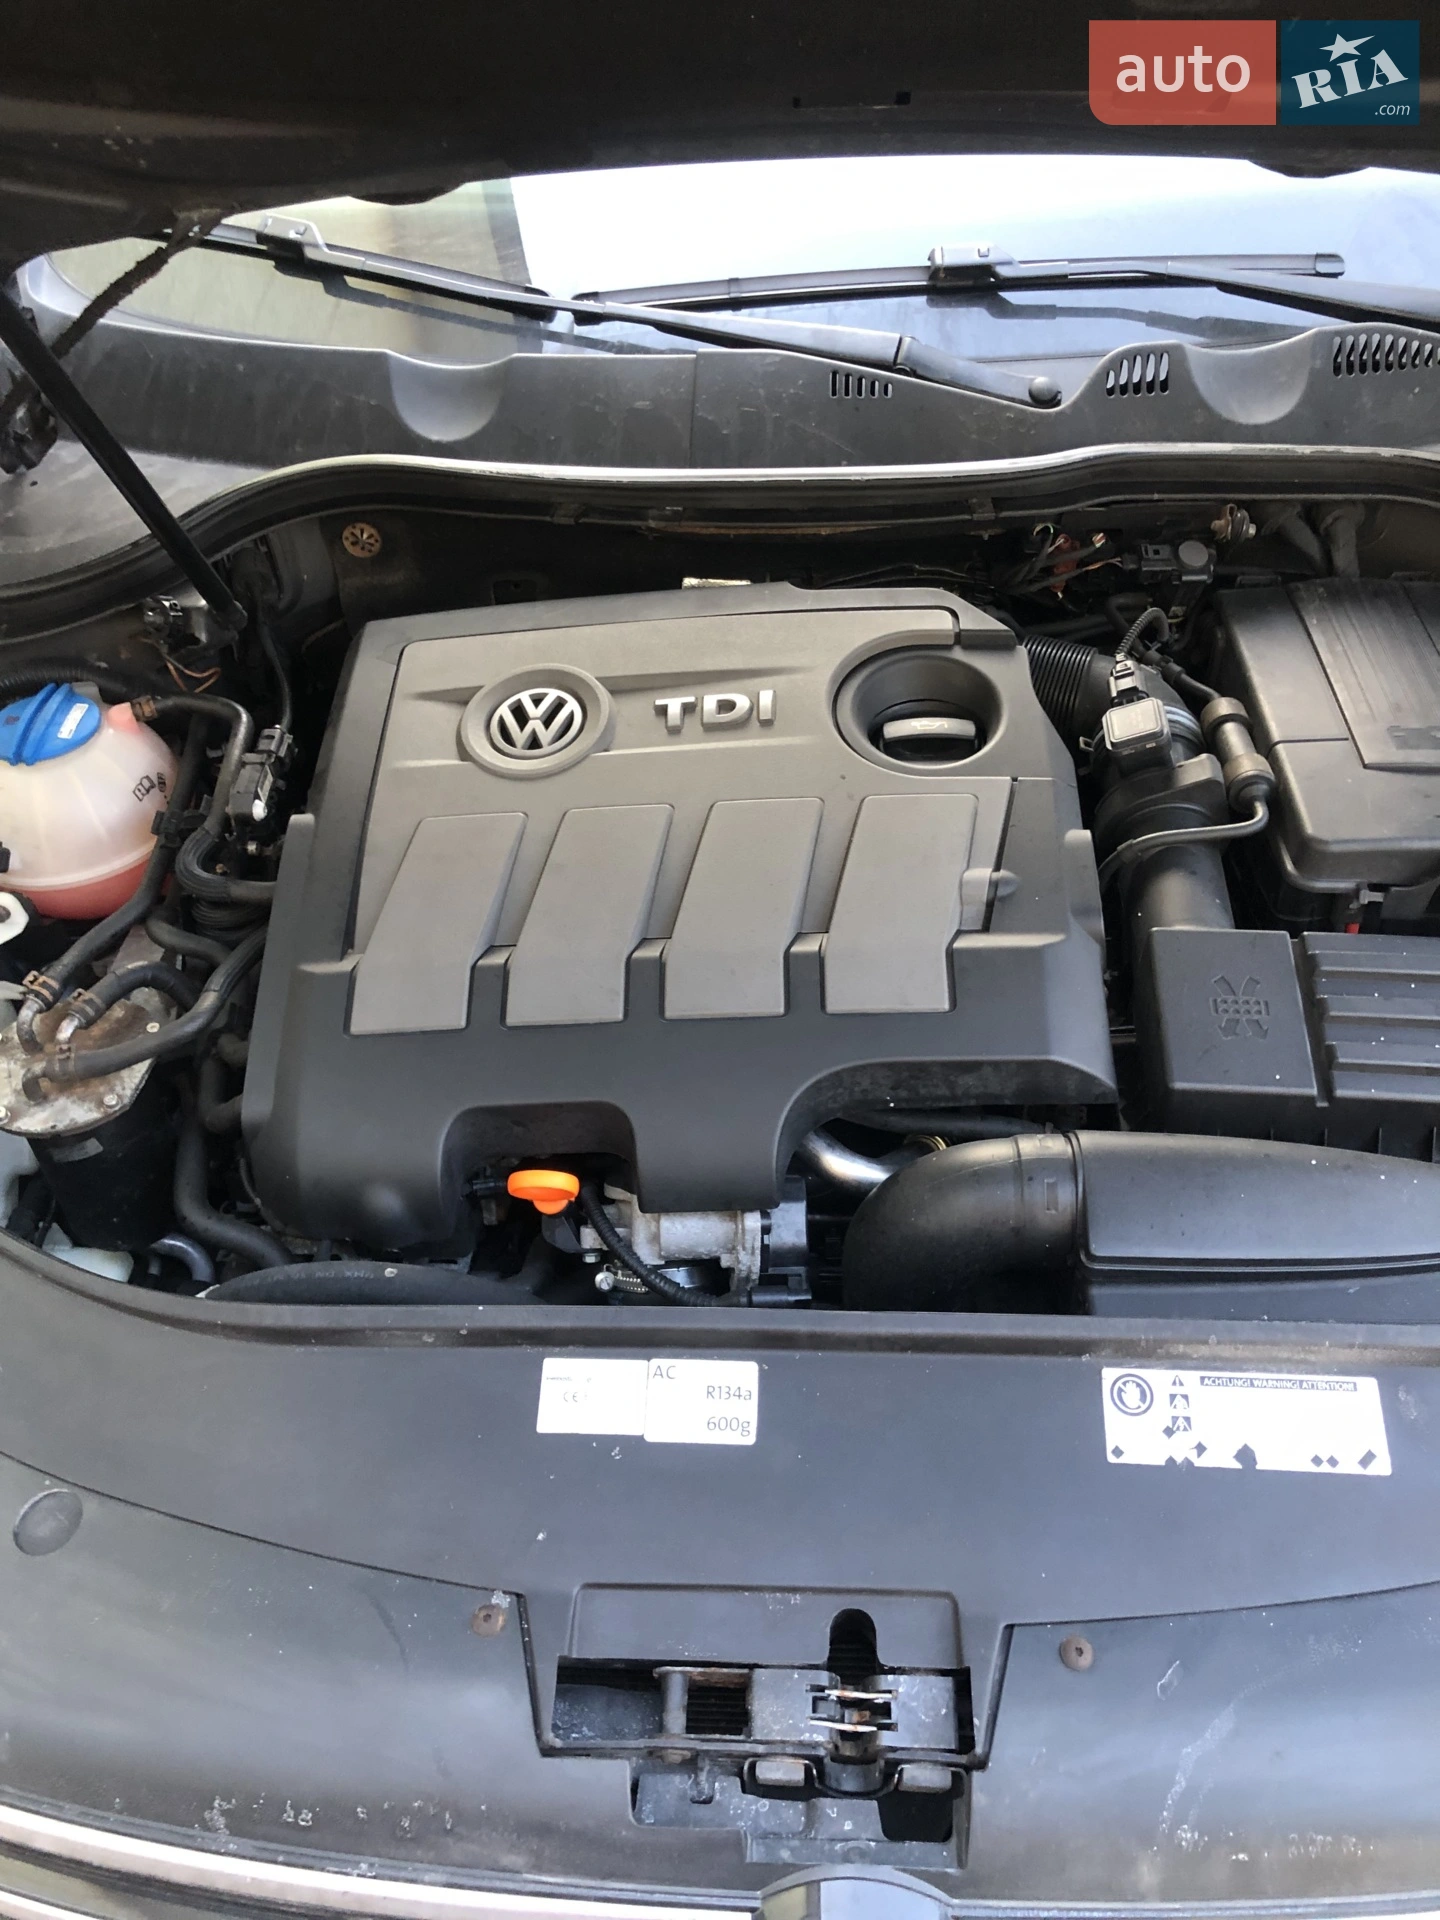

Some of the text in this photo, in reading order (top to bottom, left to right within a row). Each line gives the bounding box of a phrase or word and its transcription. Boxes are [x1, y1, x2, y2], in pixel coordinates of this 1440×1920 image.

[653, 689, 777, 734] TDI
[490, 688, 583, 757] VW
[652, 1365, 677, 1380] AC
[706, 1385, 752, 1401] R134a
[1203, 1377, 1355, 1391] ACHTUNG! WARNING! ATTENTION!
[706, 1416, 751, 1437] 600g
